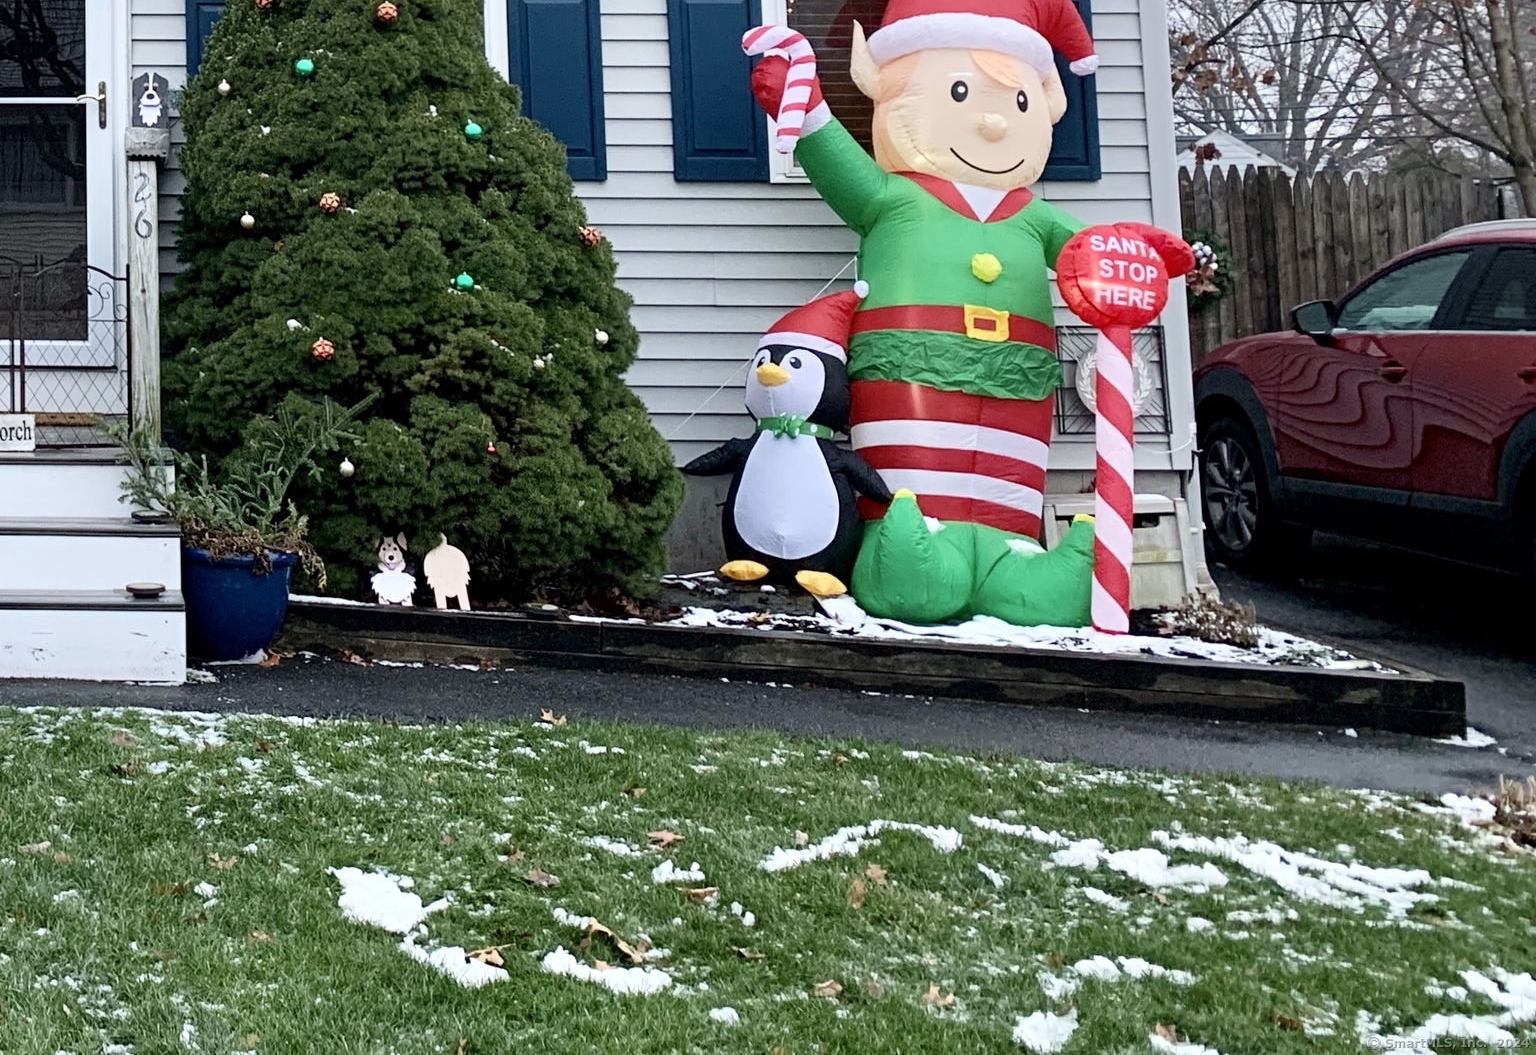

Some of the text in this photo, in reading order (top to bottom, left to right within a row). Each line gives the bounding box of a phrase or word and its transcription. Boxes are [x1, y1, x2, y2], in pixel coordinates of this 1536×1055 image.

[1091, 235, 1161, 261] SANTA
[1099, 259, 1158, 284] STOP
[1094, 287, 1156, 310] HERE
